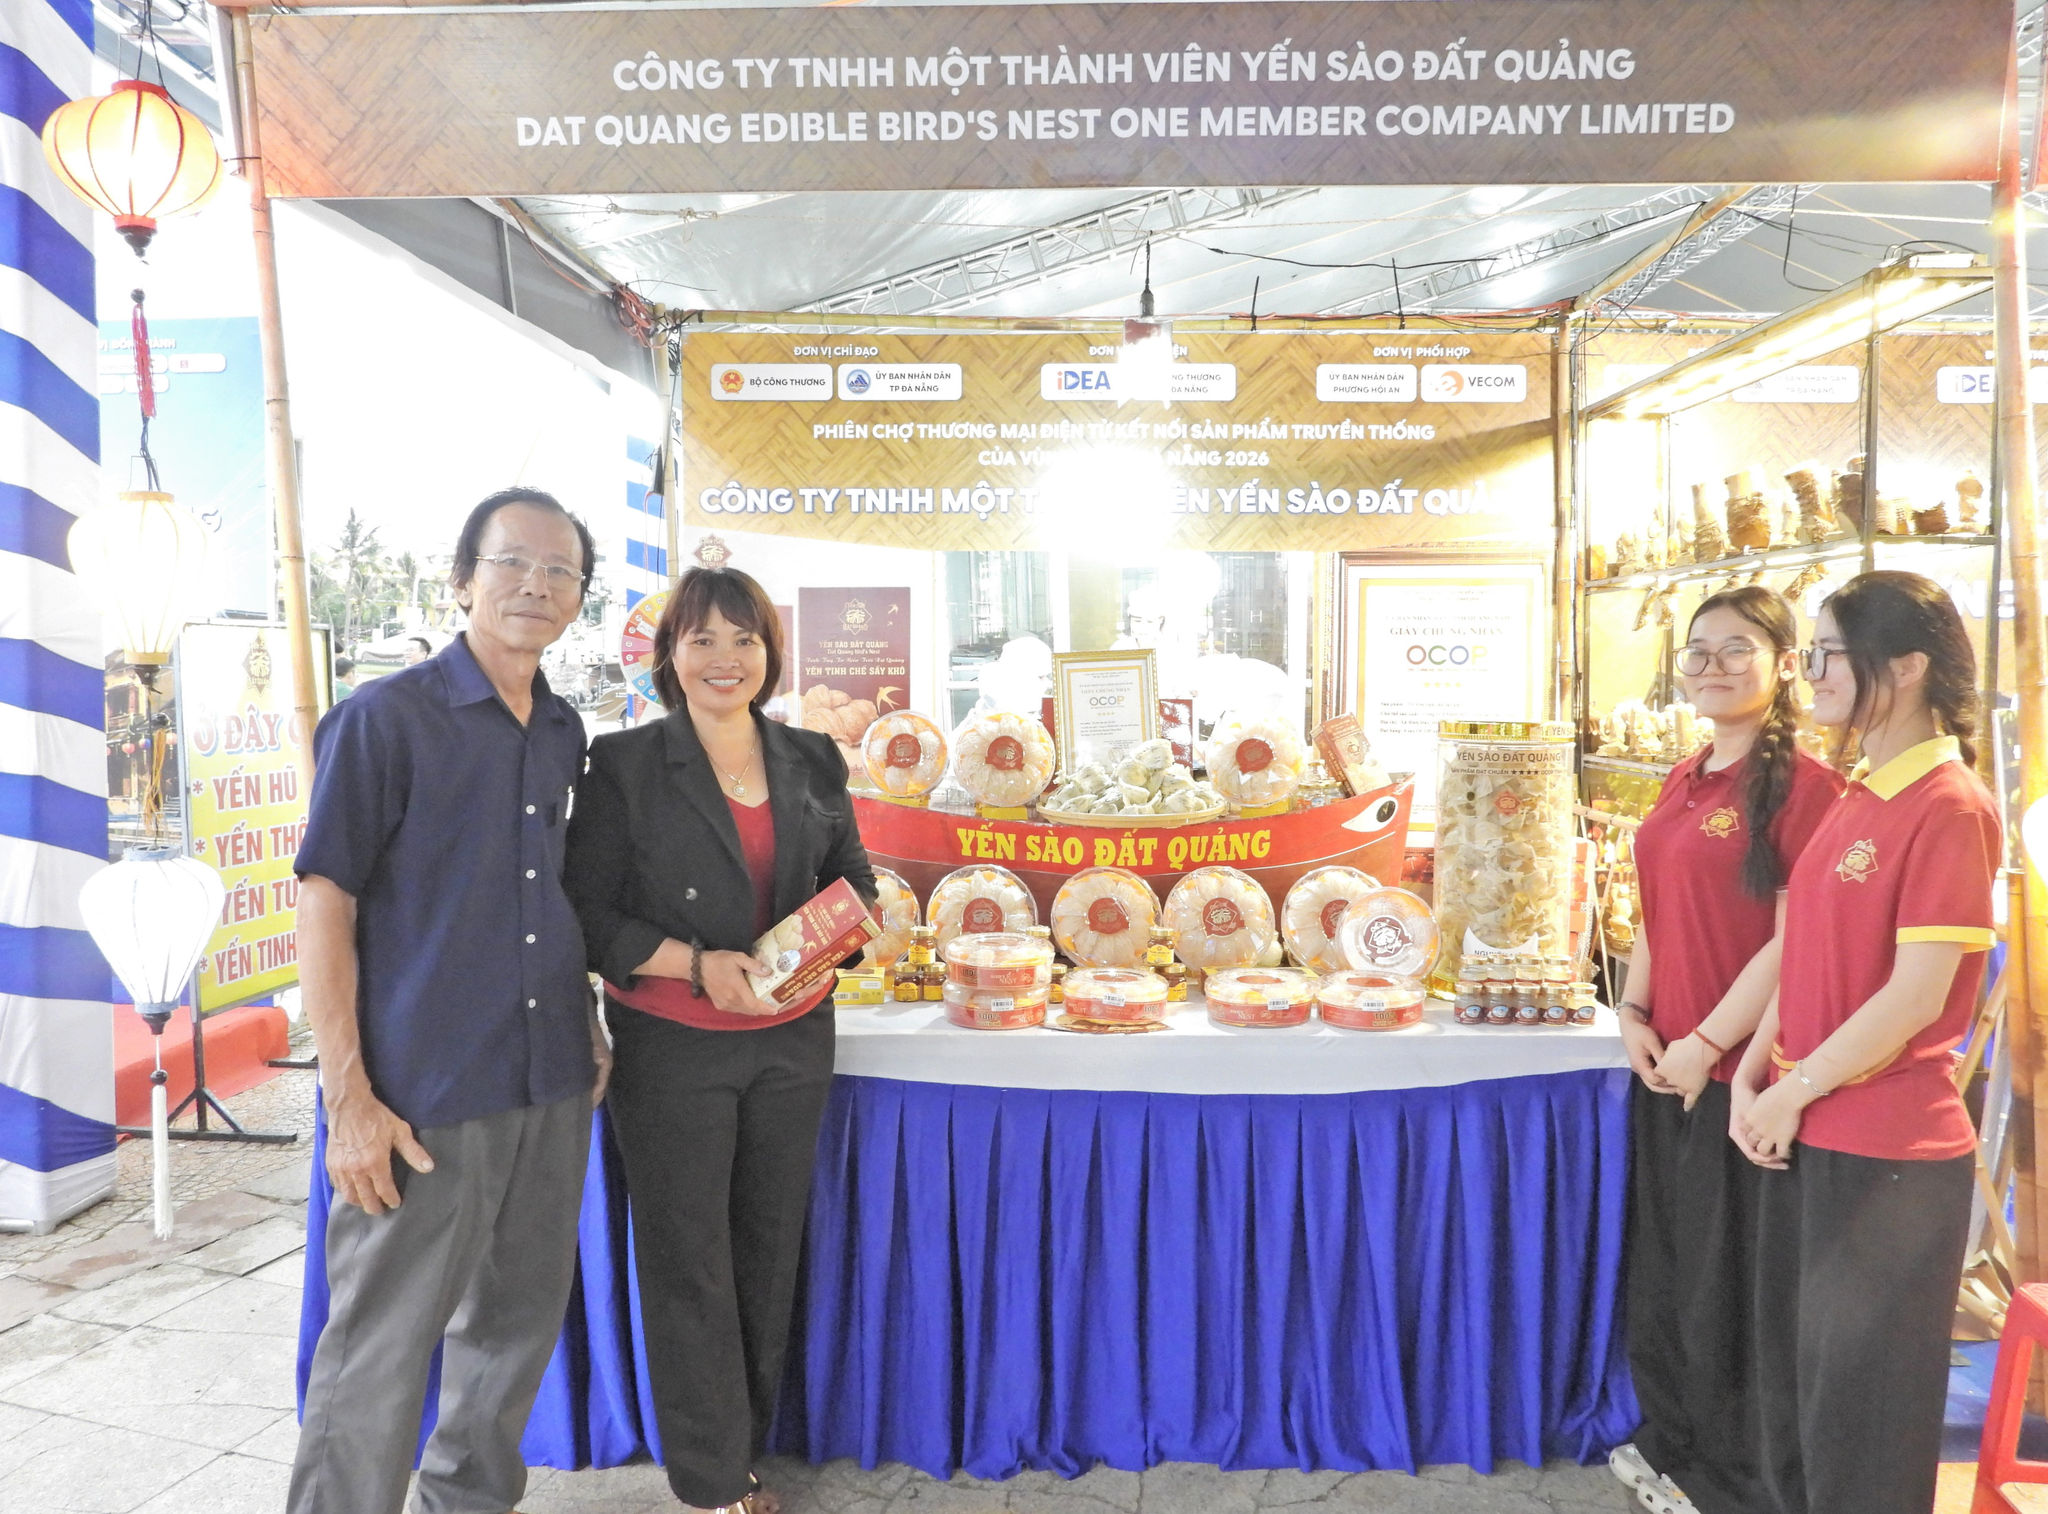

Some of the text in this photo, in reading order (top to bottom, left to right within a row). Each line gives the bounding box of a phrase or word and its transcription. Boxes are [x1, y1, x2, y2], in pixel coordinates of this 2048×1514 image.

[613, 37, 1636, 96] CÔNG TY TNHH MỘT THÀNH VIÊN YẾN SÀO ĐẤT QUẢNG
[516, 103, 1735, 148] DAT QUANG EDIBLE BIRD'S NEST ONE MEMBER COMPANY LIMITED
[794, 345, 818, 356] ĐƠN
[821, 347, 831, 359] VỊ
[854, 347, 878, 358] ĐẠO
[1089, 345, 1114, 356] ĐƠN
[1373, 344, 1470, 359] ĐƠN VỊ PHỐI HỢP
[749, 376, 826, 387] BỘ CÔNG THƯƠNG
[889, 372, 906, 380] BAN
[907, 370, 932, 380] NHÂN
[934, 370, 951, 380] DÂN
[1361, 371, 1385, 380] NHÂN
[1387, 371, 1404, 380] DÂN
[1468, 376, 1515, 388] VECOM
[901, 383, 913, 392] ĐÀ
[914, 382, 939, 392] NẴNG
[813, 420, 868, 439] PHIÊN
[872, 421, 914, 443] CHỢ
[917, 421, 997, 439] THƯƠNG
[1000, 423, 1037, 443] MẠI
[1039, 419, 1084, 443] ĐIỆN
[1152, 418, 1187, 439] NỐI
[1190, 418, 1228, 439] SẢN
[1232, 416, 1288, 439] PHẨM
[1368, 419, 1436, 440] THỐNG
[978, 445, 1017, 466] CỦA
[1224, 450, 1270, 467] 2026
[700, 480, 795, 514] CÔNG
[798, 487, 841, 514] TY
[845, 487, 934, 514] TNHH
[941, 480, 1015, 520] MỘT
[1216, 478, 1280, 514] YẾN
[1287, 480, 1351, 514] SÀO
[1357, 479, 1419, 514] ĐẤT
[1406, 645, 1488, 666] OCOP
[805, 665, 905, 676] YẾN TINH CHẾ SẤY KHÔ
[1089, 695, 1125, 706] OCOP
[223, 703, 280, 750] ĐÂY
[1456, 750, 1561, 763] YẾN SÀO ĐẤT QUẢNG
[212, 763, 298, 811] YẾN HŨ
[214, 820, 263, 868] YẾN
[956, 822, 1271, 870] YẾN SÀO ĐẤT QUẢNG
[219, 877, 265, 926] YẾN
[214, 937, 253, 985] YẾN
